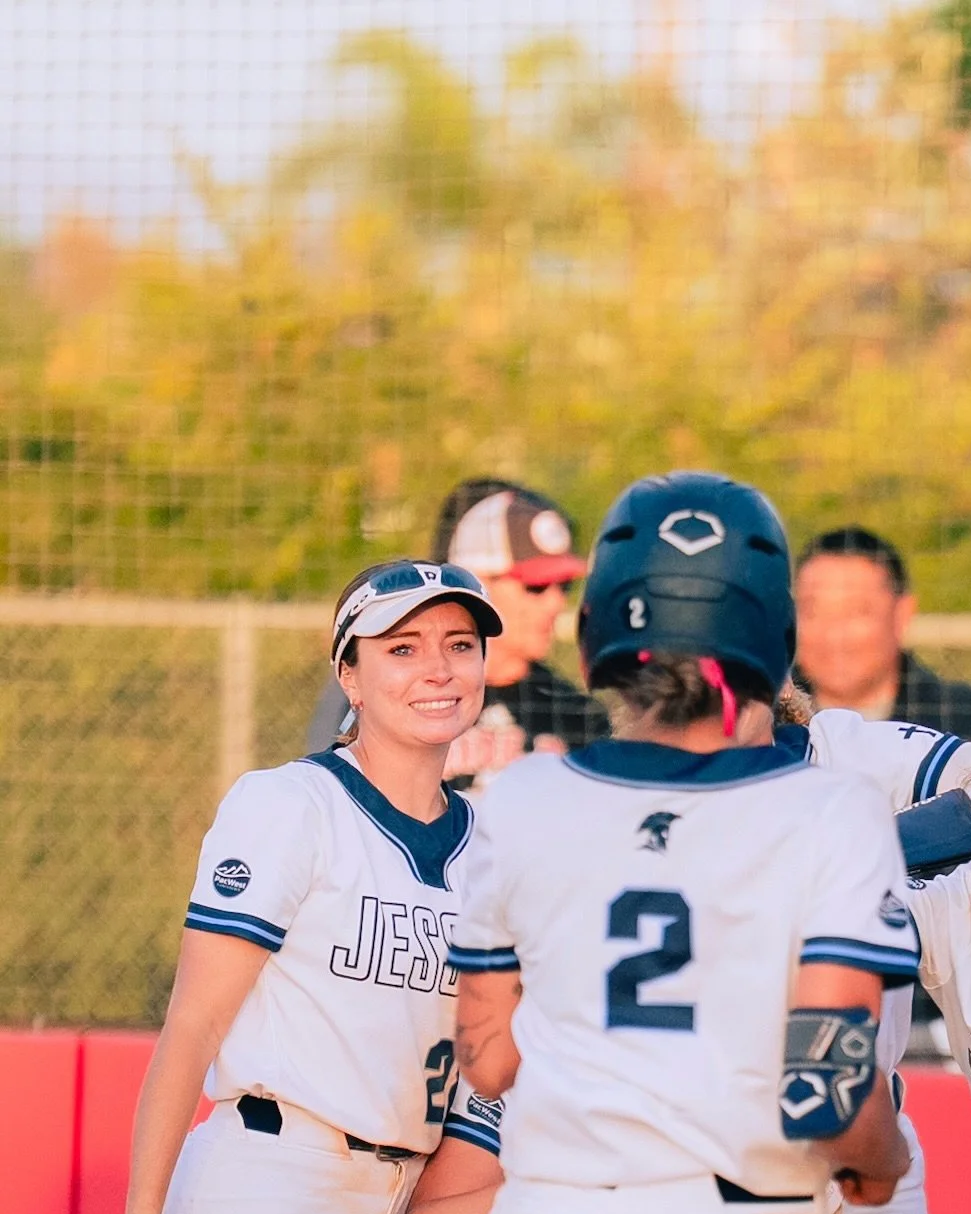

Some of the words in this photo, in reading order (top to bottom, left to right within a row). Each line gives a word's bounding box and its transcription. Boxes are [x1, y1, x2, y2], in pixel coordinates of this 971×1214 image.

[629, 598, 646, 628] 2
[214, 875, 247, 890] PacWest
[606, 889, 695, 1032] 2
[424, 1039, 460, 1123] 2
